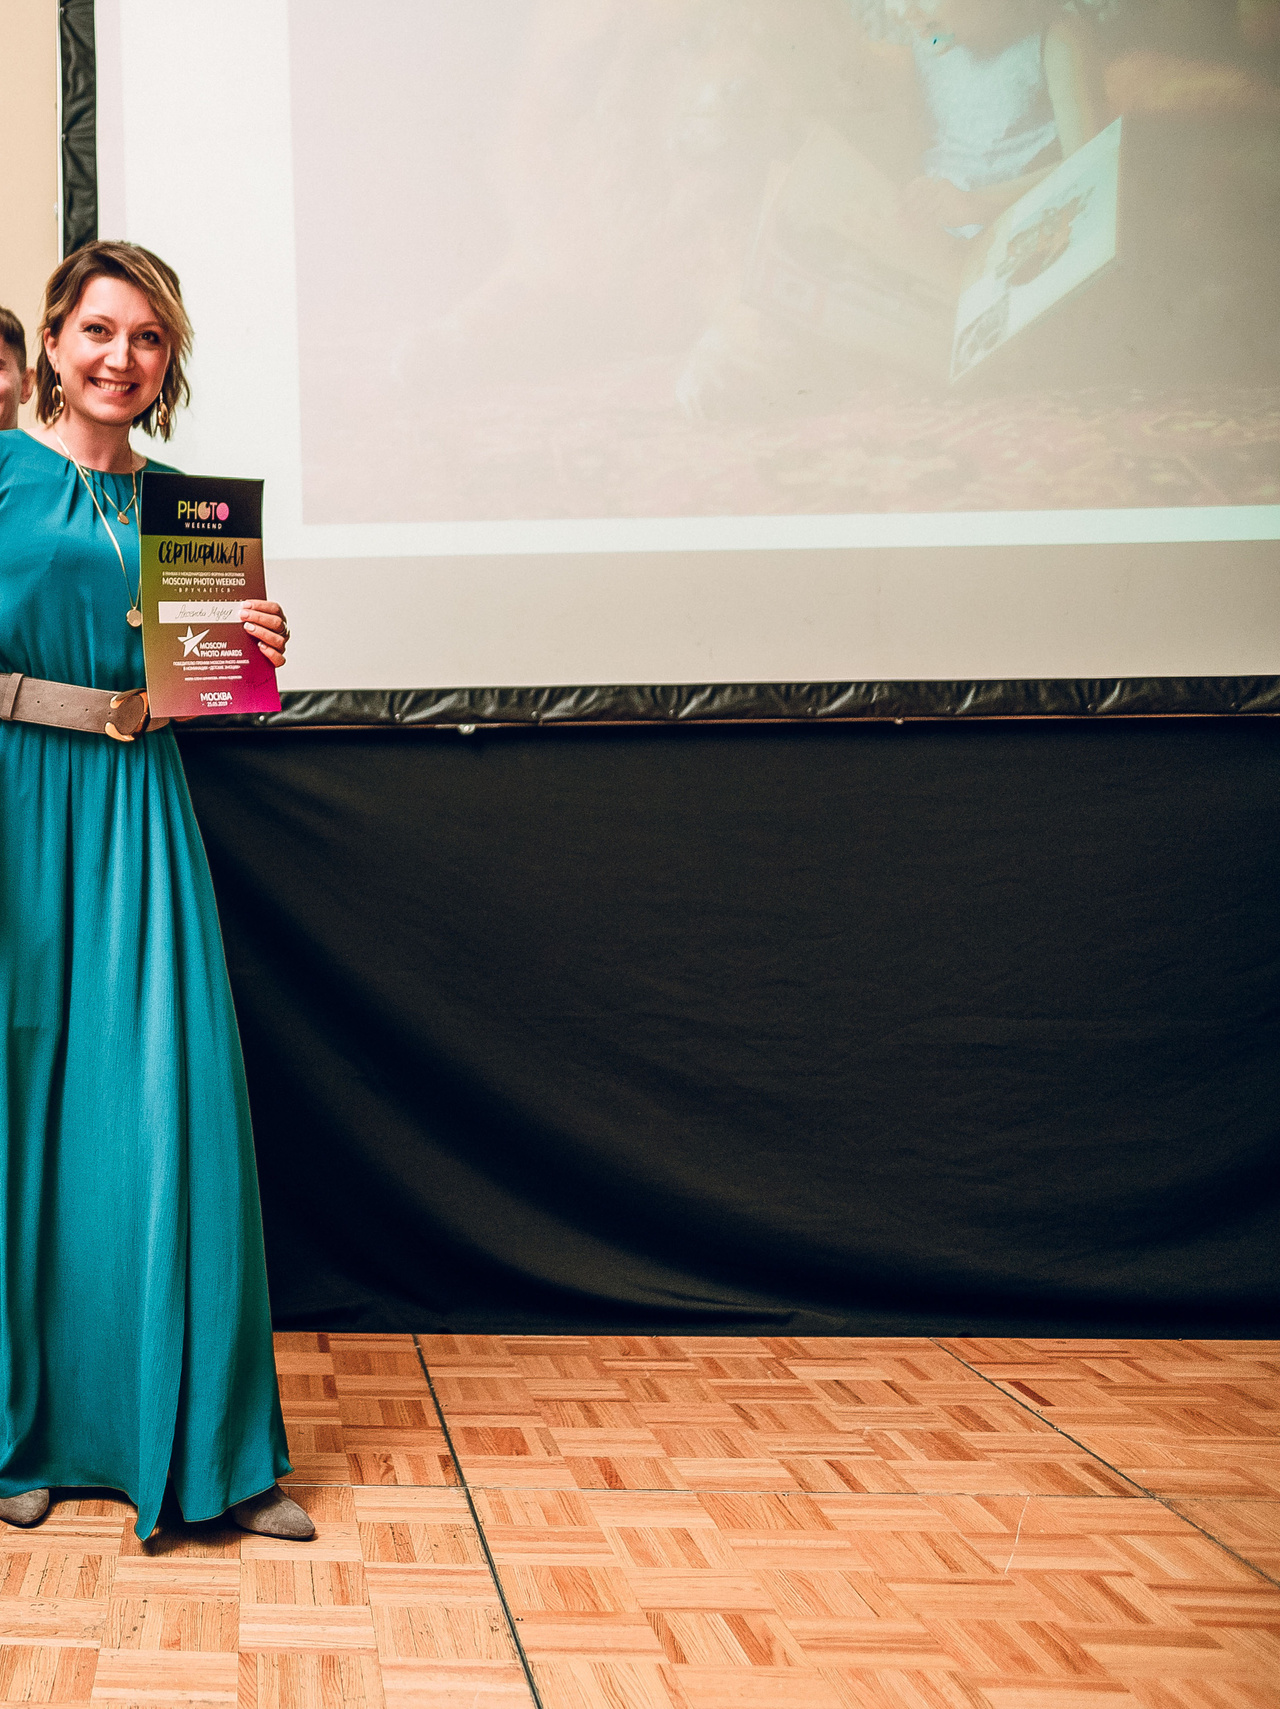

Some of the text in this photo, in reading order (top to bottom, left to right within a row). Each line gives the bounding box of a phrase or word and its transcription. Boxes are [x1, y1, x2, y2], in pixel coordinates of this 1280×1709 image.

[177, 500, 230, 521] PHOTO
[184, 522, 223, 530] WEEKEND
[158, 540, 248, 567] СЕРТИФИКАТ
[162, 577, 246, 586] MOSCOW PHOTO WEEKEND
[199, 642, 228, 650] MOSCOW
[220, 649, 243, 657] AWARDS
[200, 691, 233, 702] МОСКВА
